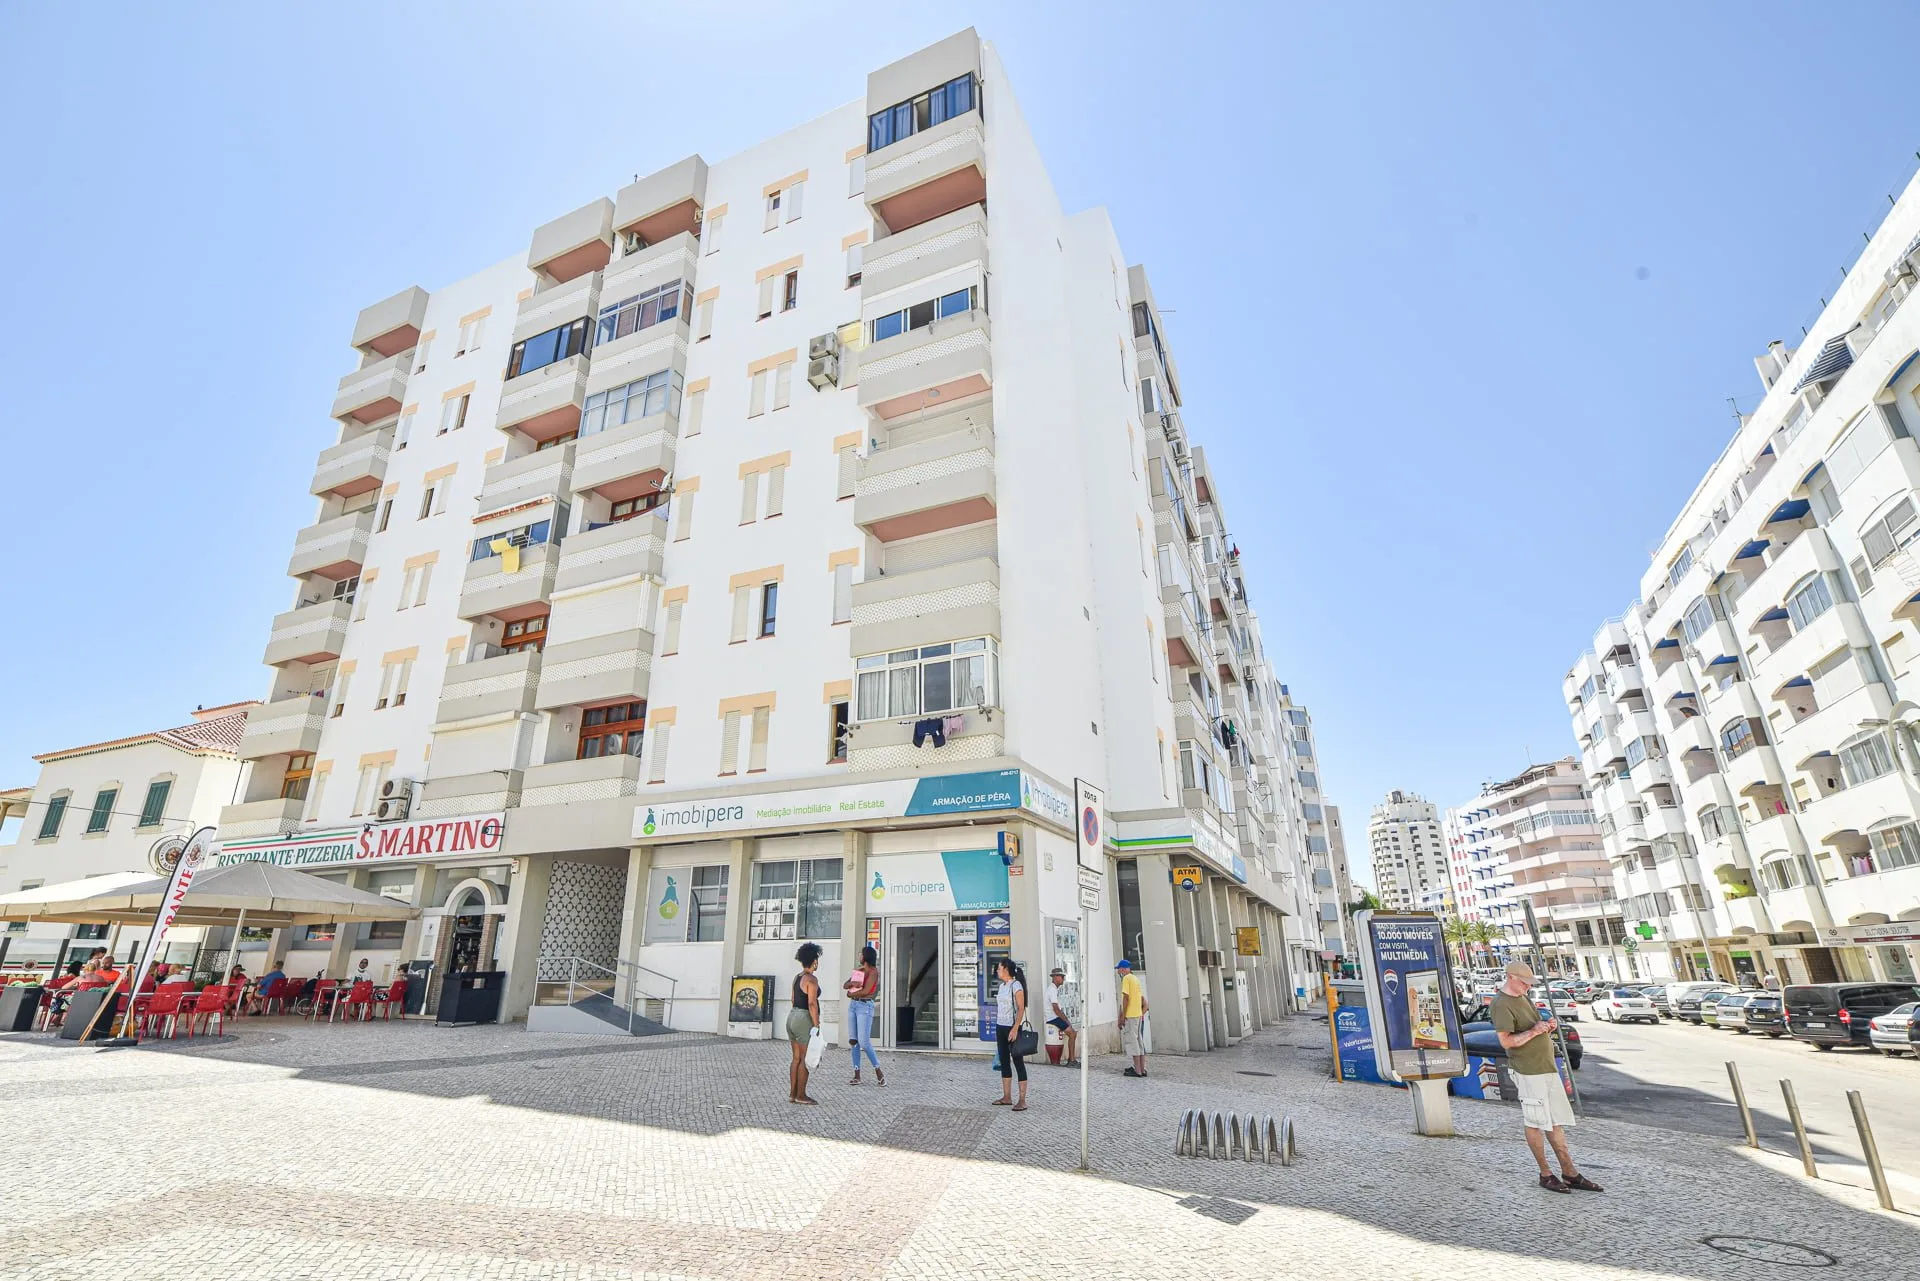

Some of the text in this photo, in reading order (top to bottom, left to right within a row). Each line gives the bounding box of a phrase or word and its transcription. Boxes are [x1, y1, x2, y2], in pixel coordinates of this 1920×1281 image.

[839, 799, 885, 811] Real Estate
[932, 794, 973, 806] ARMAÇÃO
[974, 794, 986, 803] DE
[661, 805, 744, 828] imobipera
[756, 807, 792, 820] Mediação
[295, 844, 354, 863] PIZZERIA
[890, 880, 945, 897] imobipera
[960, 901, 987, 909] ARMAÇÃO
[1377, 931, 1402, 940] 10.000
[1380, 948, 1429, 961] MULTIMÉDIA
